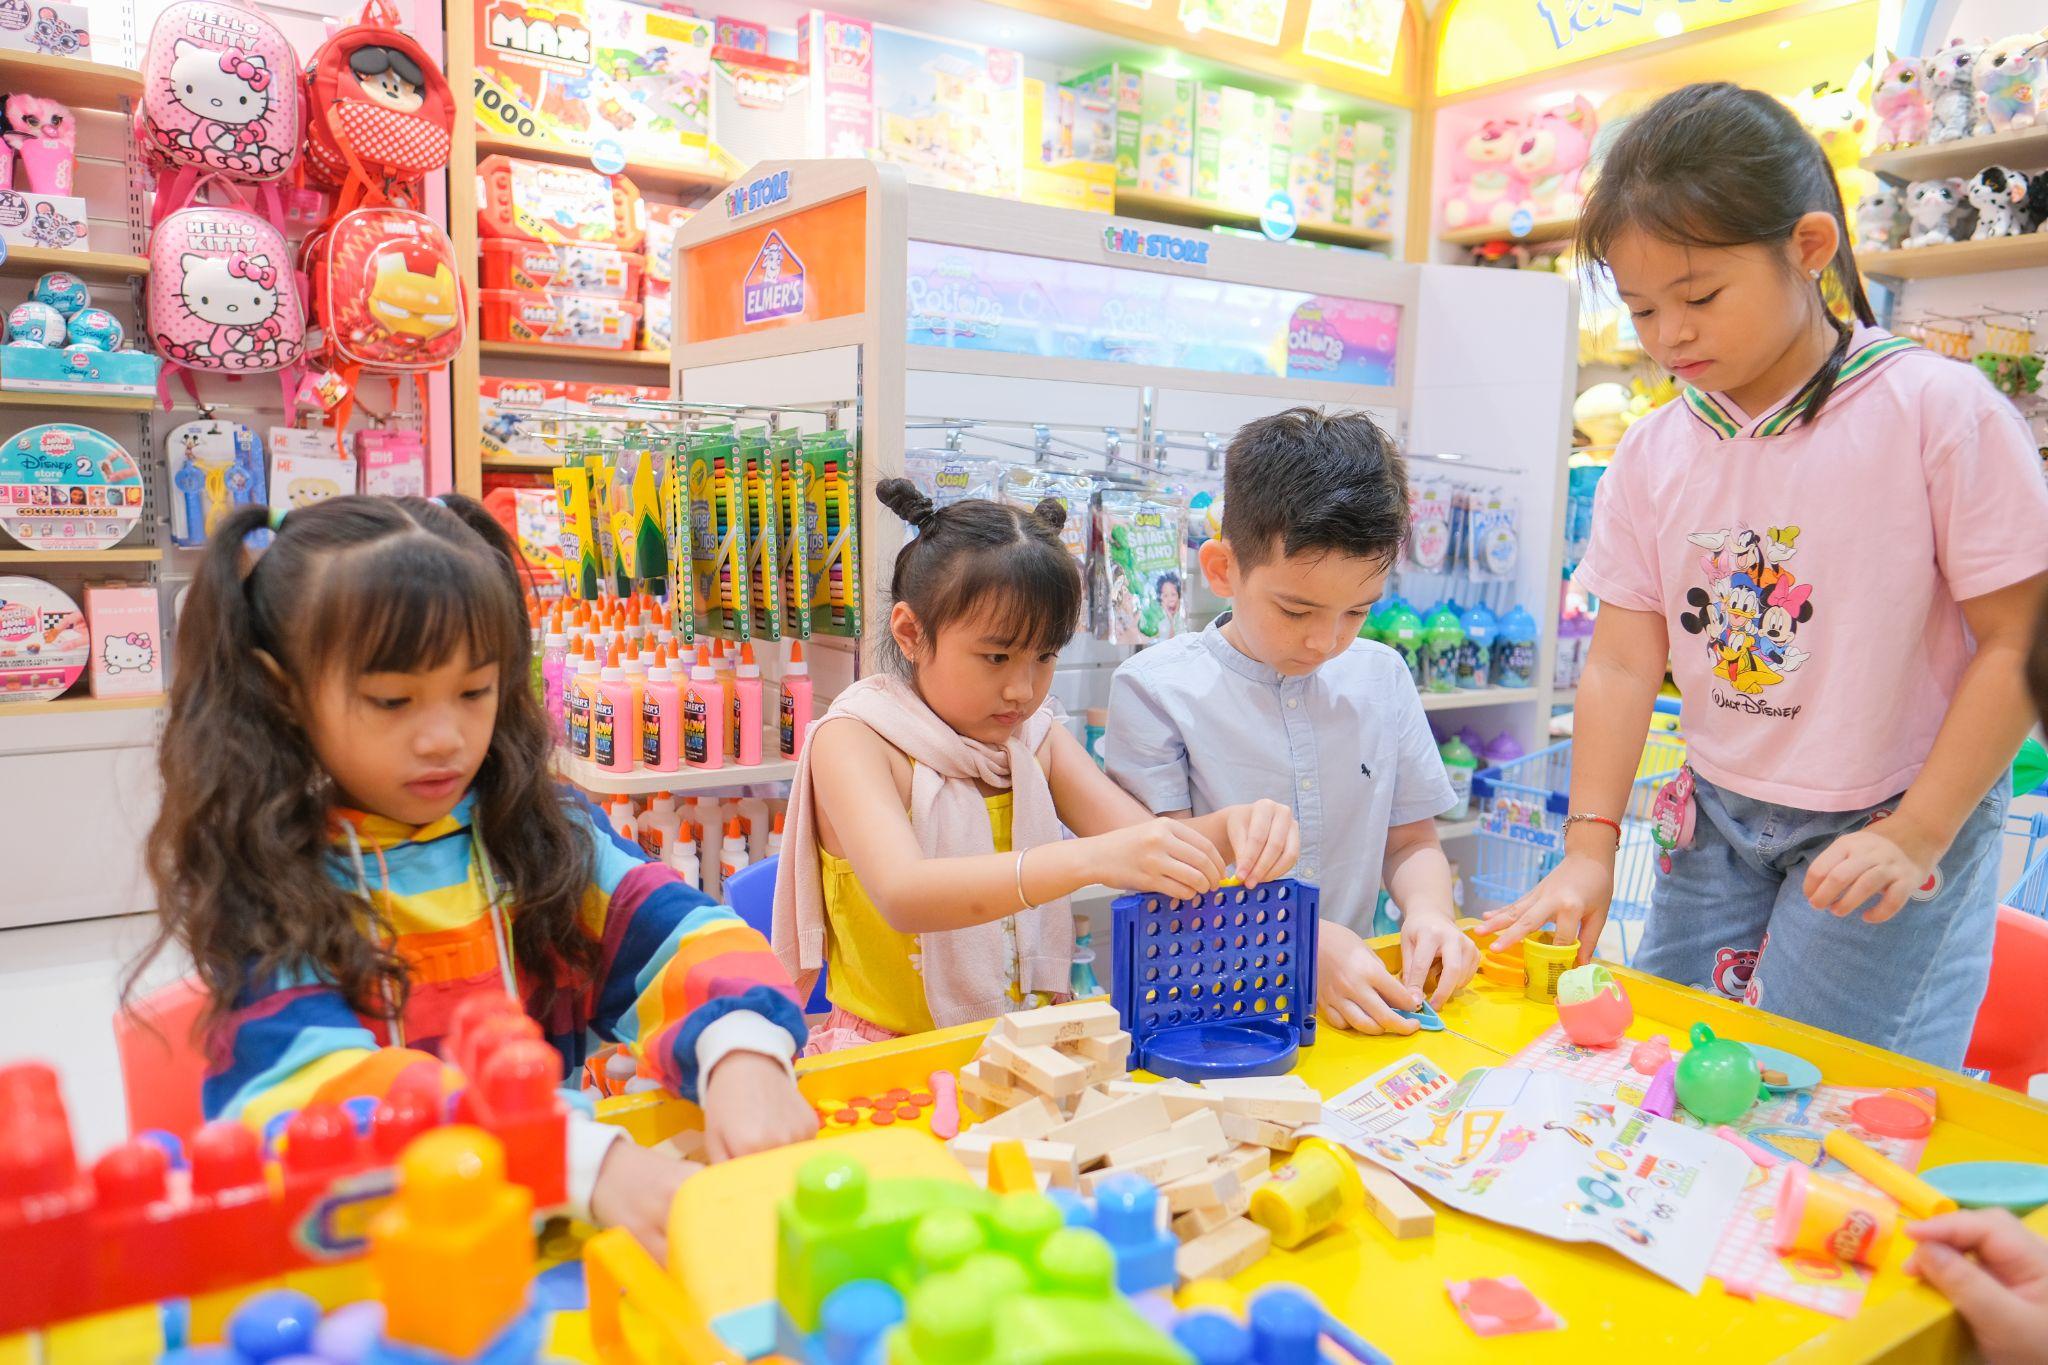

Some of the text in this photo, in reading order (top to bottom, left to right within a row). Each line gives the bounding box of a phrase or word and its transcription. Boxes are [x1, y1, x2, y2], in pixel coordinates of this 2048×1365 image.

[185, 21, 260, 52] KITTY
[187, 7, 260, 36] HELLO
[491, 12, 590, 64] MAX
[474, 78, 536, 138] 1000
[749, 170, 788, 211] STORE
[186, 221, 257, 236] HELLO
[187, 235, 257, 253] KITTY
[1146, 234, 1210, 265] STORE
[747, 280, 801, 315] ELMER'S
[908, 275, 1004, 326] Potions
[1289, 326, 1345, 362] otions
[17, 453, 94, 477] Disney 2
[34, 469, 63, 478] store
[16, 507, 118, 517] COLLECTOR'S CASE
[1135, 544, 1173, 561] SAND
[1736, 693, 1802, 720] Disney
